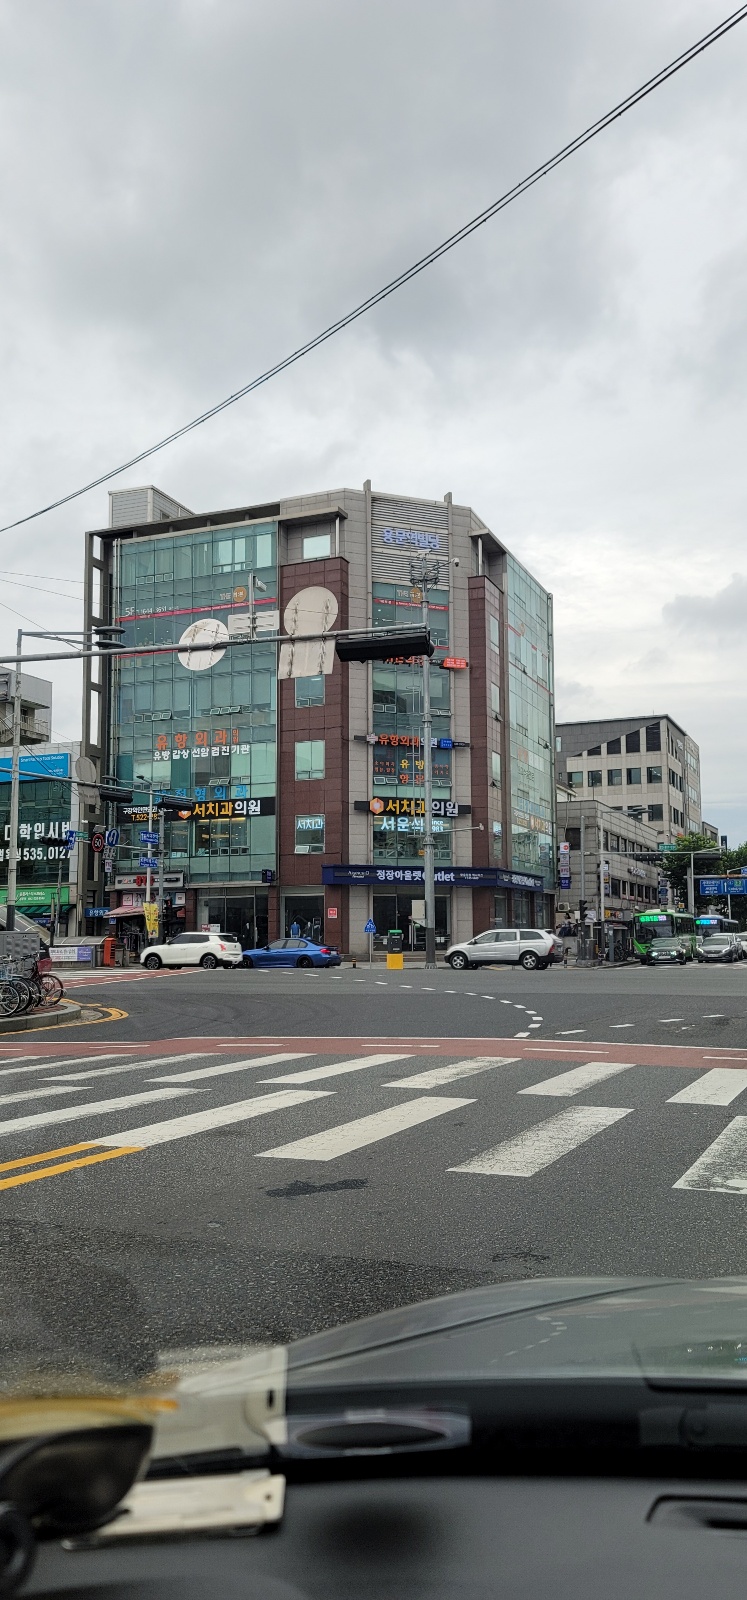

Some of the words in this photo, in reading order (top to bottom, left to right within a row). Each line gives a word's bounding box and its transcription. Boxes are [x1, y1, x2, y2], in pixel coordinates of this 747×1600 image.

[156, 729, 227, 750] 유항외과
[297, 818, 324, 830] 서치과
[95, 838, 101, 847] 50
[376, 870, 422, 881] 정장아울렛
